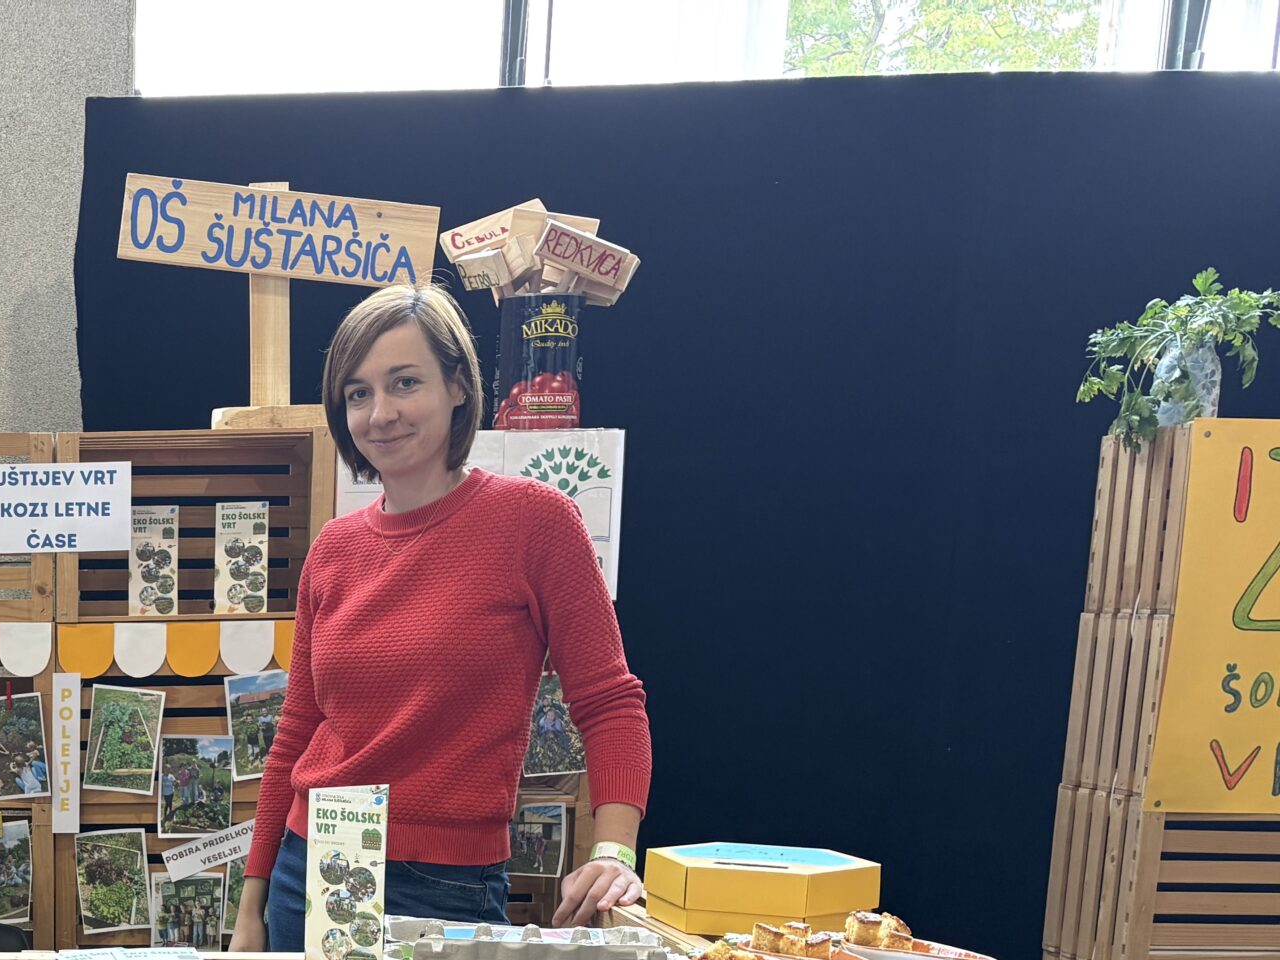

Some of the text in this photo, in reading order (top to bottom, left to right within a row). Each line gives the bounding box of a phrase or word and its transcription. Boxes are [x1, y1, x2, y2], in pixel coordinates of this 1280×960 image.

[130, 179, 358, 253] OŠ MILANA
[450, 227, 509, 250] ČEBULA
[201, 213, 417, 284] ŠUŠTARŠIČA
[540, 228, 622, 279] REDKVICA
[522, 319, 578, 338] MIKADO
[80, 470, 117, 485] VRT
[54, 502, 111, 517] LETNE
[238, 512, 266, 520] ŠOLSKI
[27, 530, 77, 549] ČASE
[59, 689, 73, 811] POLETJE
[316, 808, 381, 824] EKO ŠOLSKI
[316, 823, 337, 834] VRT
[165, 825, 253, 863] POBIRA PRIDELKOV
[201, 846, 241, 865] VESELJE!
